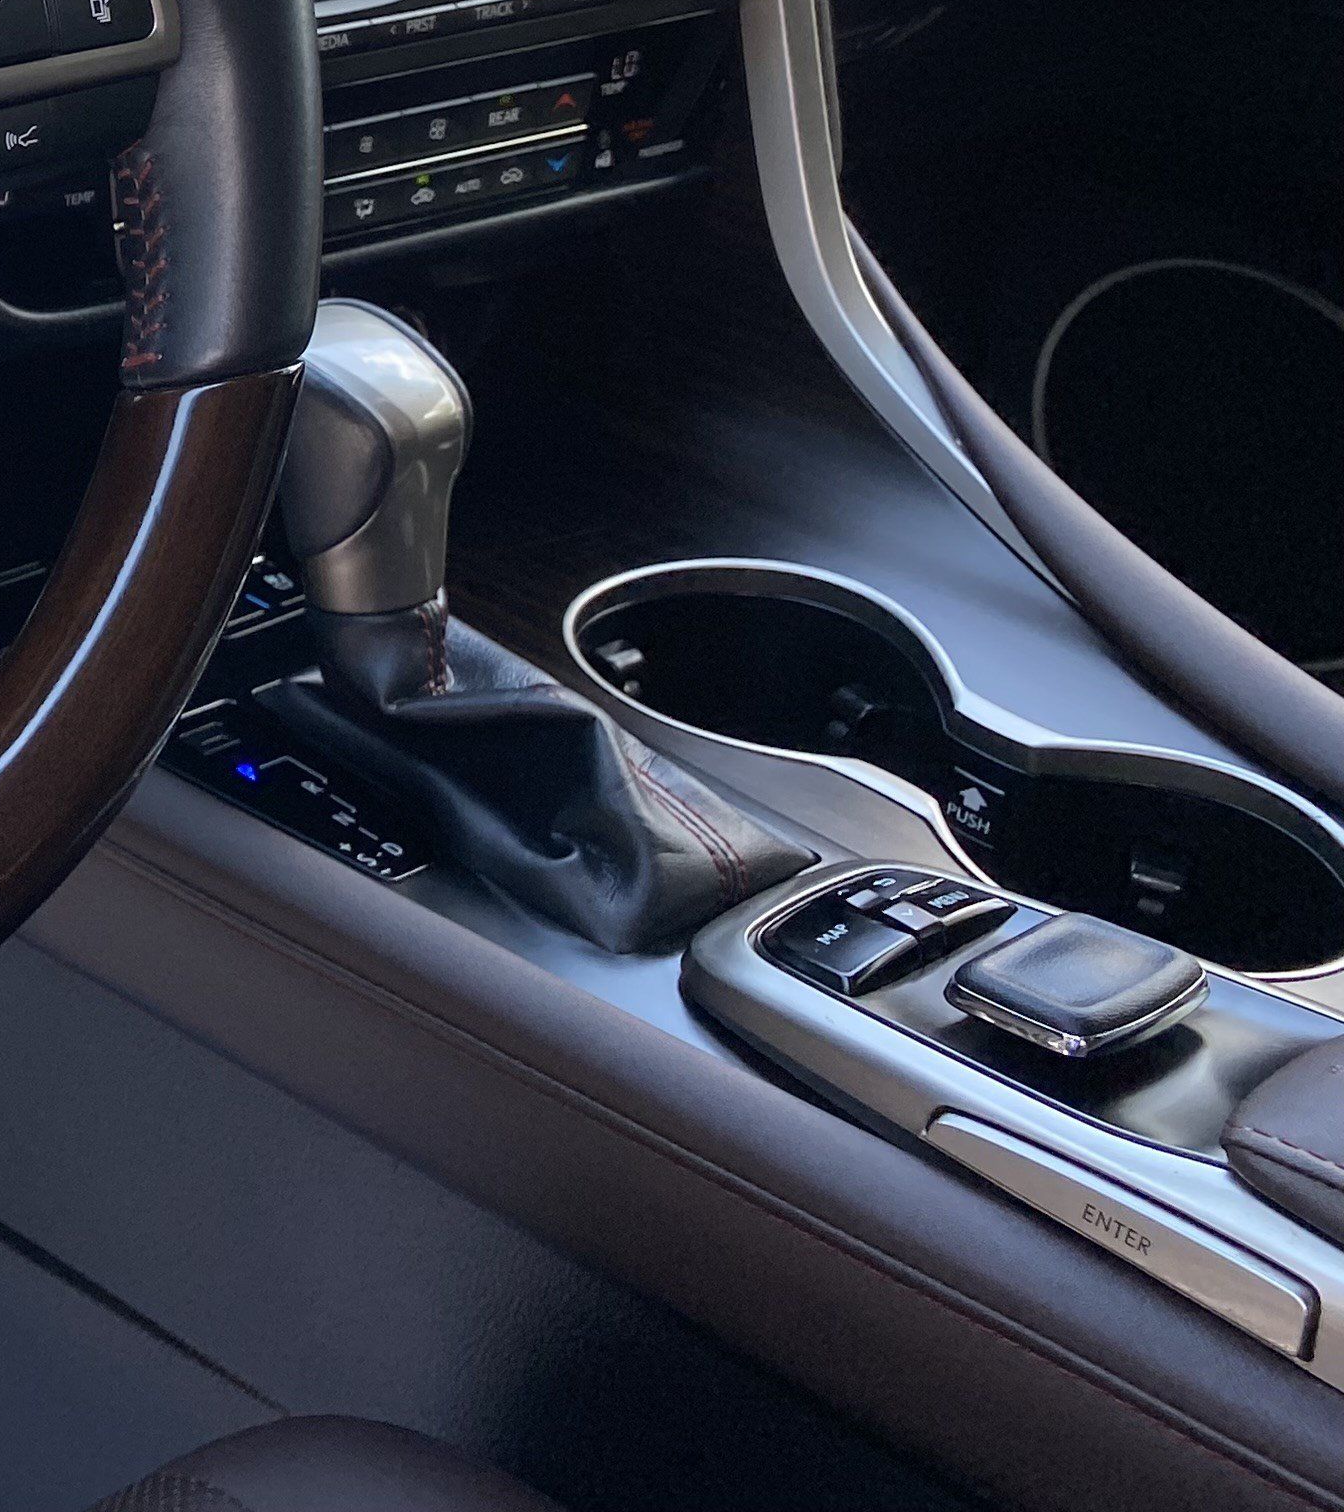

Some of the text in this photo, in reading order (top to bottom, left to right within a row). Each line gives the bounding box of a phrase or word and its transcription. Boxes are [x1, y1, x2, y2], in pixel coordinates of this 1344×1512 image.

[318, 34, 349, 51] EDIA
[947, 801, 990, 836] PUSH
[816, 923, 848, 945] MAP
[1080, 1202, 1152, 1256] ENTER
